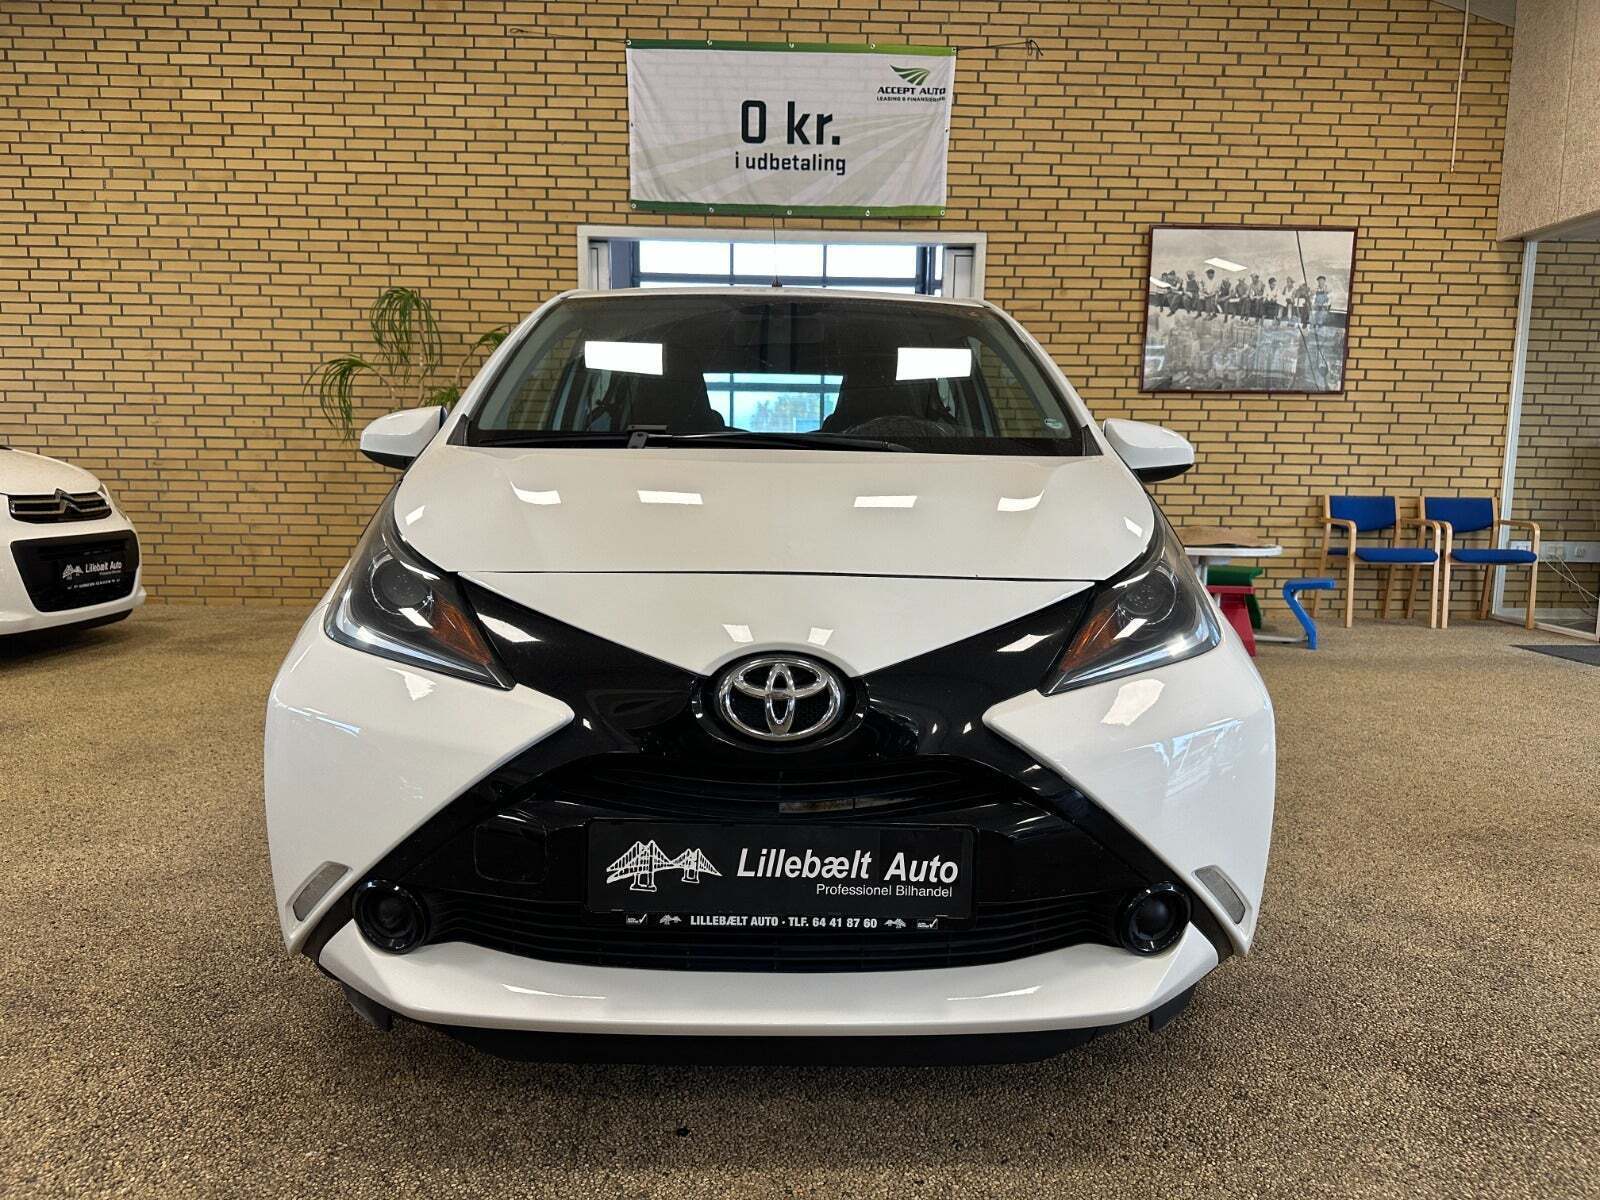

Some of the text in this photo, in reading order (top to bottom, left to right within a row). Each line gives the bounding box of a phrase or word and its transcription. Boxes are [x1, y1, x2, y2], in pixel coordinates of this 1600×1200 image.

[878, 86, 946, 95] ACCEPT AUTO
[741, 100, 841, 145] 0 kr.
[735, 151, 846, 176] i udbetaling
[736, 848, 959, 884] Lillebælt Auto
[816, 883, 954, 898] Professionel Bilhandel
[690, 915, 748, 926] LILLEBÆLT
[750, 916, 779, 927] AUTO
[788, 917, 809, 927] TLF.
[812, 917, 827, 927] 64
[829, 917, 842, 928] 41
[846, 918, 861, 928] 87
[863, 918, 878, 929] 60
